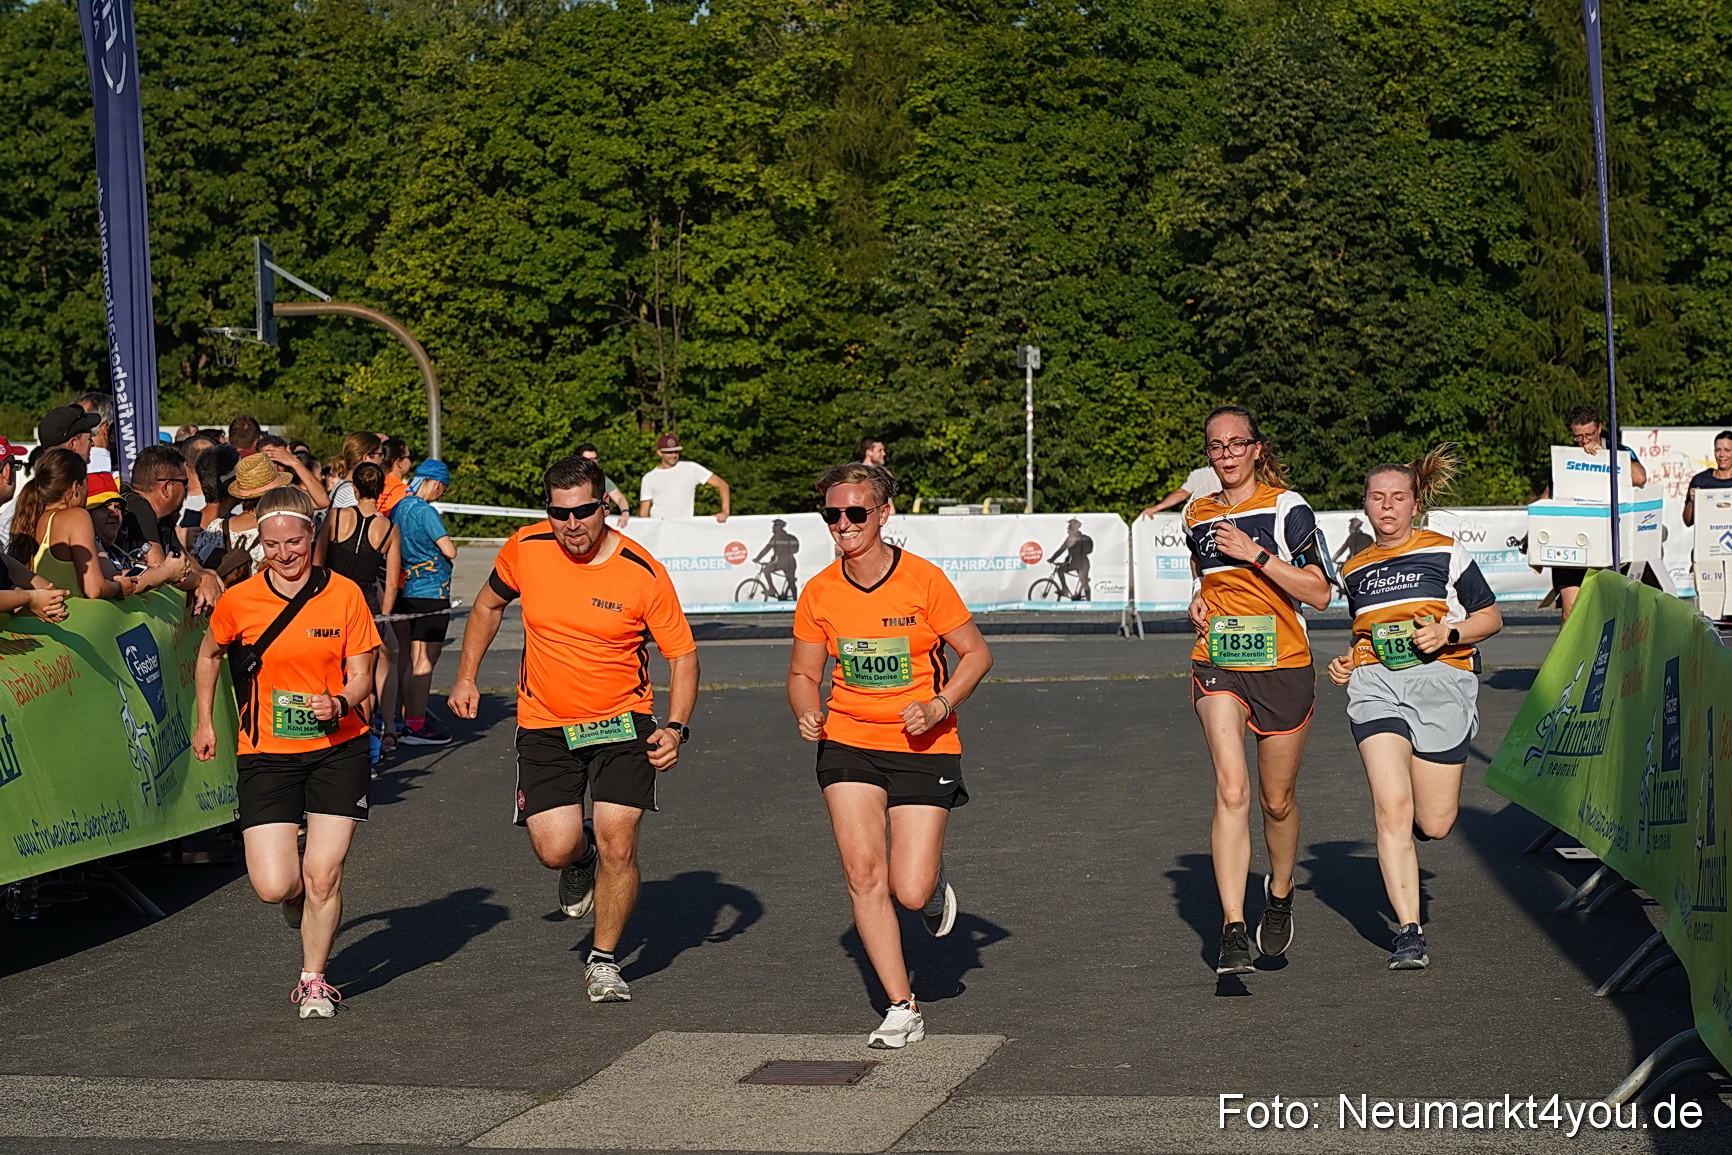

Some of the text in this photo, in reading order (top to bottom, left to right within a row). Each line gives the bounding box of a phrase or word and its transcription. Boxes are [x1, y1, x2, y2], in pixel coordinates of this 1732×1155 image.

[1566, 460, 1621, 474] Schmit
[1155, 535, 1186, 548] NOW
[1452, 530, 1487, 543] NOW
[662, 556, 726, 571] HRRÄDER
[943, 556, 1022, 571] FAHRRÄDER
[1366, 571, 1424, 591] Fischer
[1370, 582, 1420, 596] AUTOMOBILE
[592, 597, 623, 612] THULE
[881, 615, 917, 627] THULE
[306, 628, 341, 638] THULE
[1219, 633, 1265, 650] 1838
[1266, 635, 1274, 659] 2022
[1384, 637, 1414, 655] 183
[133, 654, 159, 677] Fischer
[843, 659, 852, 677] RUN
[850, 655, 899, 673] 1400
[900, 656, 910, 681] 2022
[854, 672, 898, 681] Watts Denise
[275, 710, 283, 729] RUN
[284, 707, 318, 726] 139
[600, 727, 622, 736] Patrick
